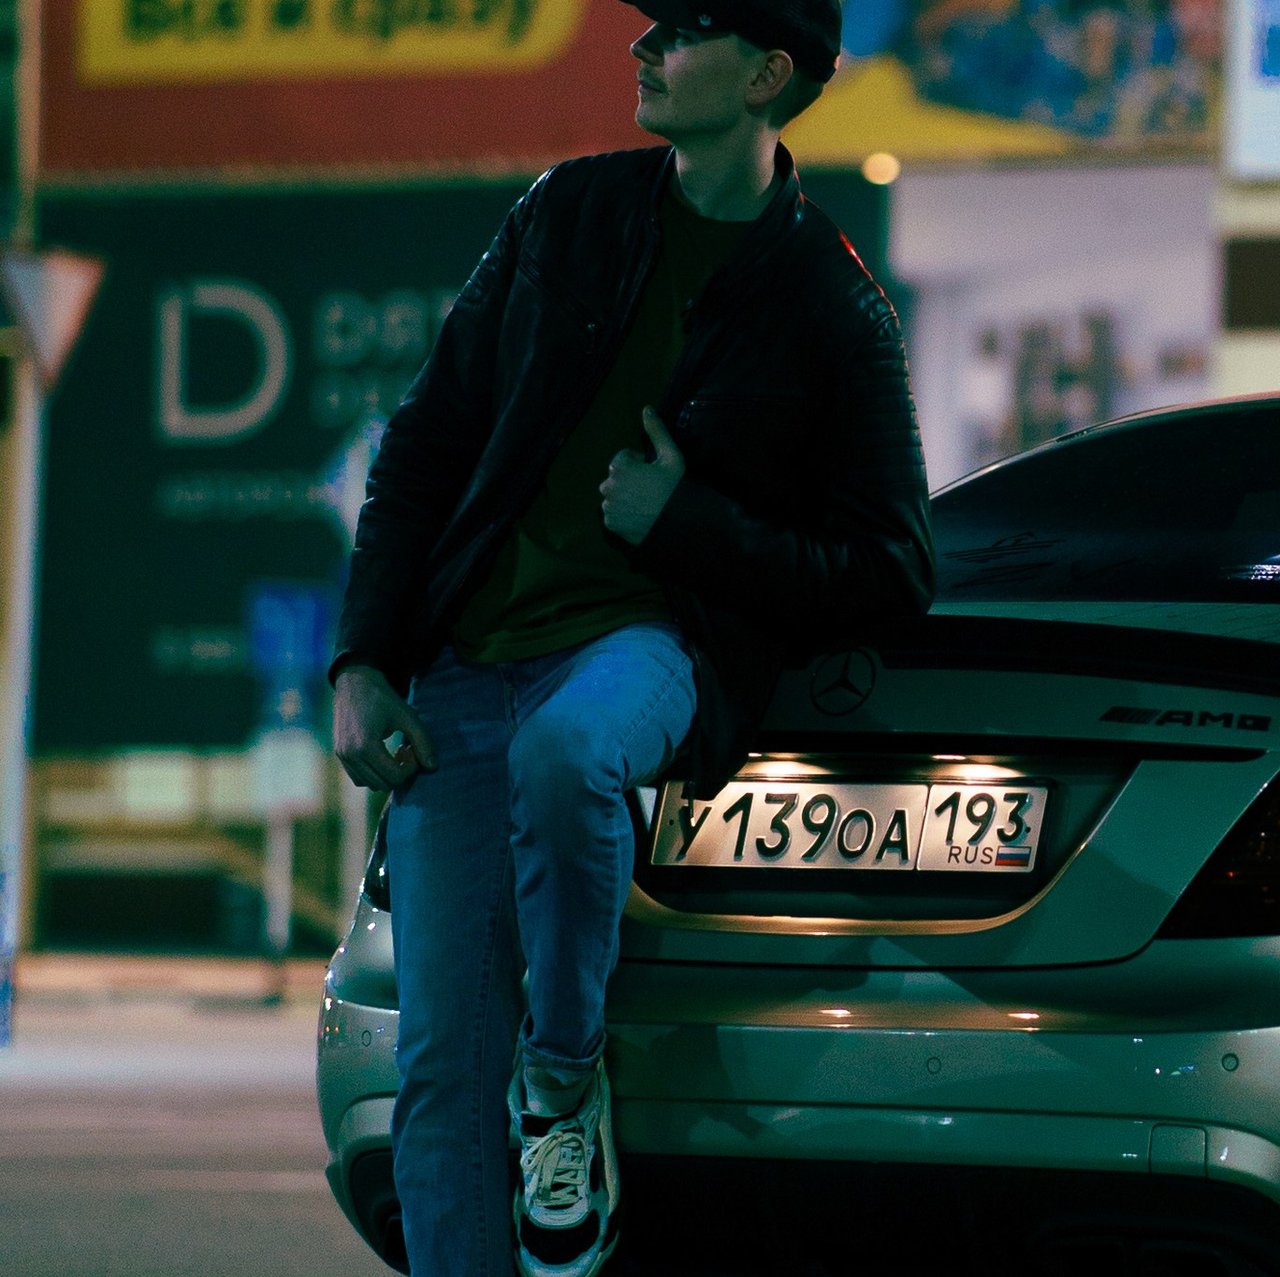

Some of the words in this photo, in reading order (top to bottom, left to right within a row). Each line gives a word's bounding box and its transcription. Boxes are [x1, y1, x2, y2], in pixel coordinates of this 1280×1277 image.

[1154, 709, 1273, 733] AMG
[934, 791, 1029, 844] 193
[947, 844, 995, 865] RUS
